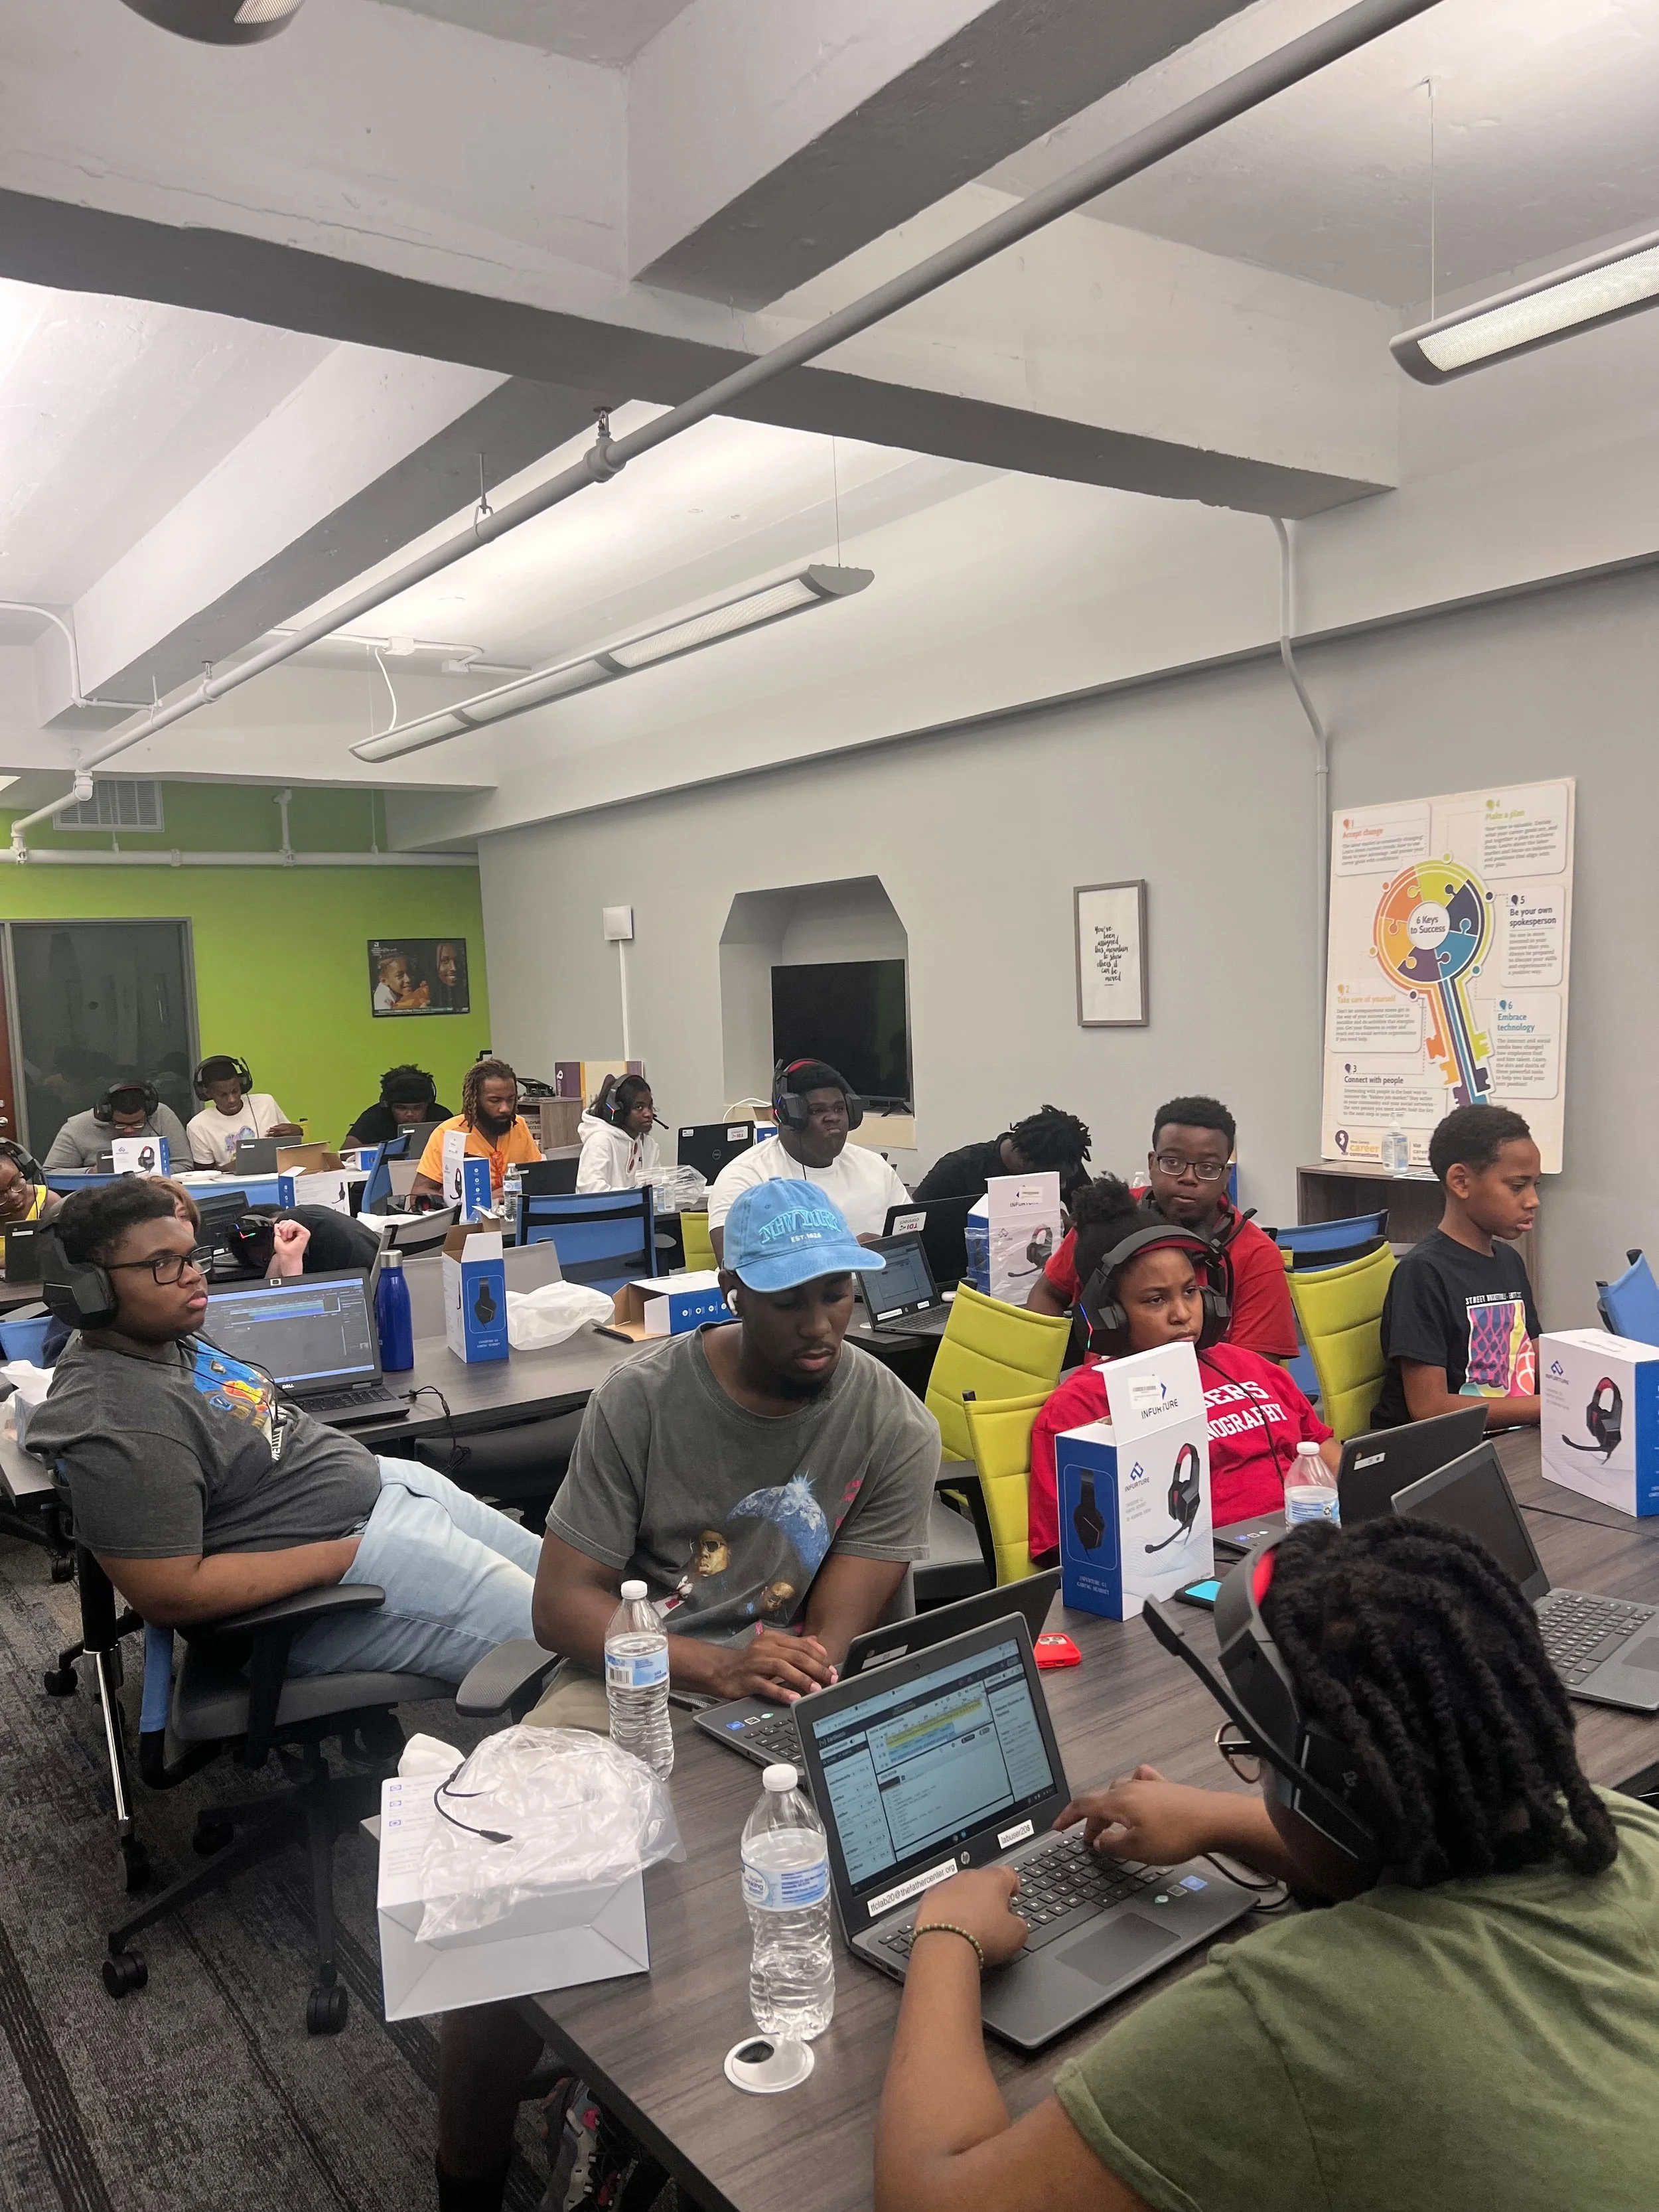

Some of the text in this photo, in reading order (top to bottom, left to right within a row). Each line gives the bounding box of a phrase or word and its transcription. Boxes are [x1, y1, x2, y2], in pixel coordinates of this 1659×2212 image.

[1520, 895, 1525, 904] 5
[1520, 909, 1537, 917] your
[1422, 916, 1439, 925] Keys
[1509, 918, 1556, 928] spokesperson
[1110, 952, 1122, 961] show
[1497, 1023, 1536, 1033] technology
[1383, 1076, 1404, 1085] people
[758, 1209, 841, 1244] NEW YORK
[1465, 1295, 1486, 1305] STREET
[1203, 1380, 1270, 1409] ERS
[1125, 1477, 1150, 1493] INFURTURE
[1000, 1824, 1031, 1844] labuser20$
[870, 1864, 956, 1912] tfclab20@thefathercenter.org
